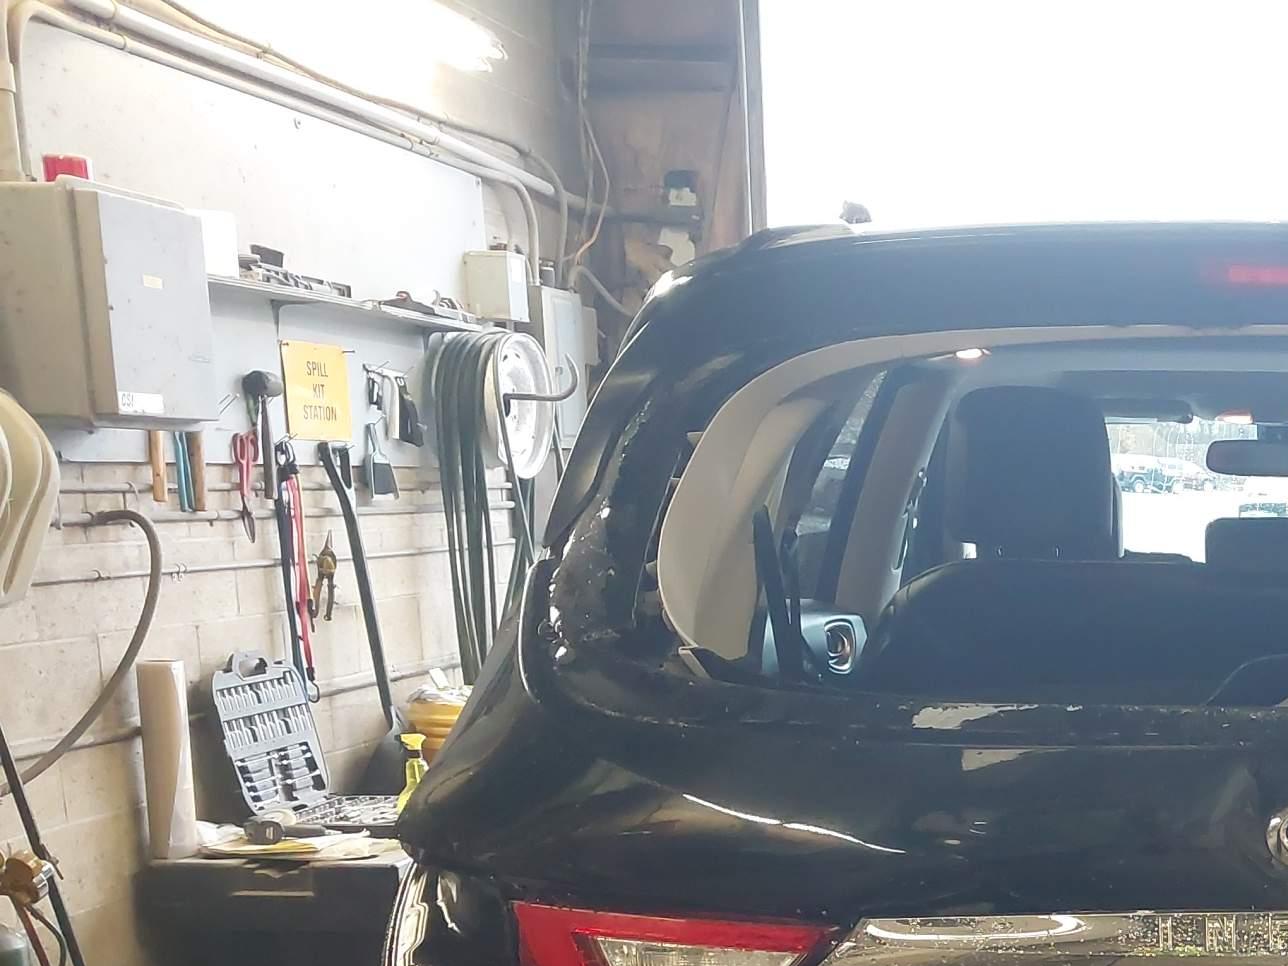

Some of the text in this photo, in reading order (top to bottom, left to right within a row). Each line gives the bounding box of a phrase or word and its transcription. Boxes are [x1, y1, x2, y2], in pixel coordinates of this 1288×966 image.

[306, 360, 329, 378] SPILL
[312, 383, 325, 399] KIT
[303, 404, 337, 422] STATION
